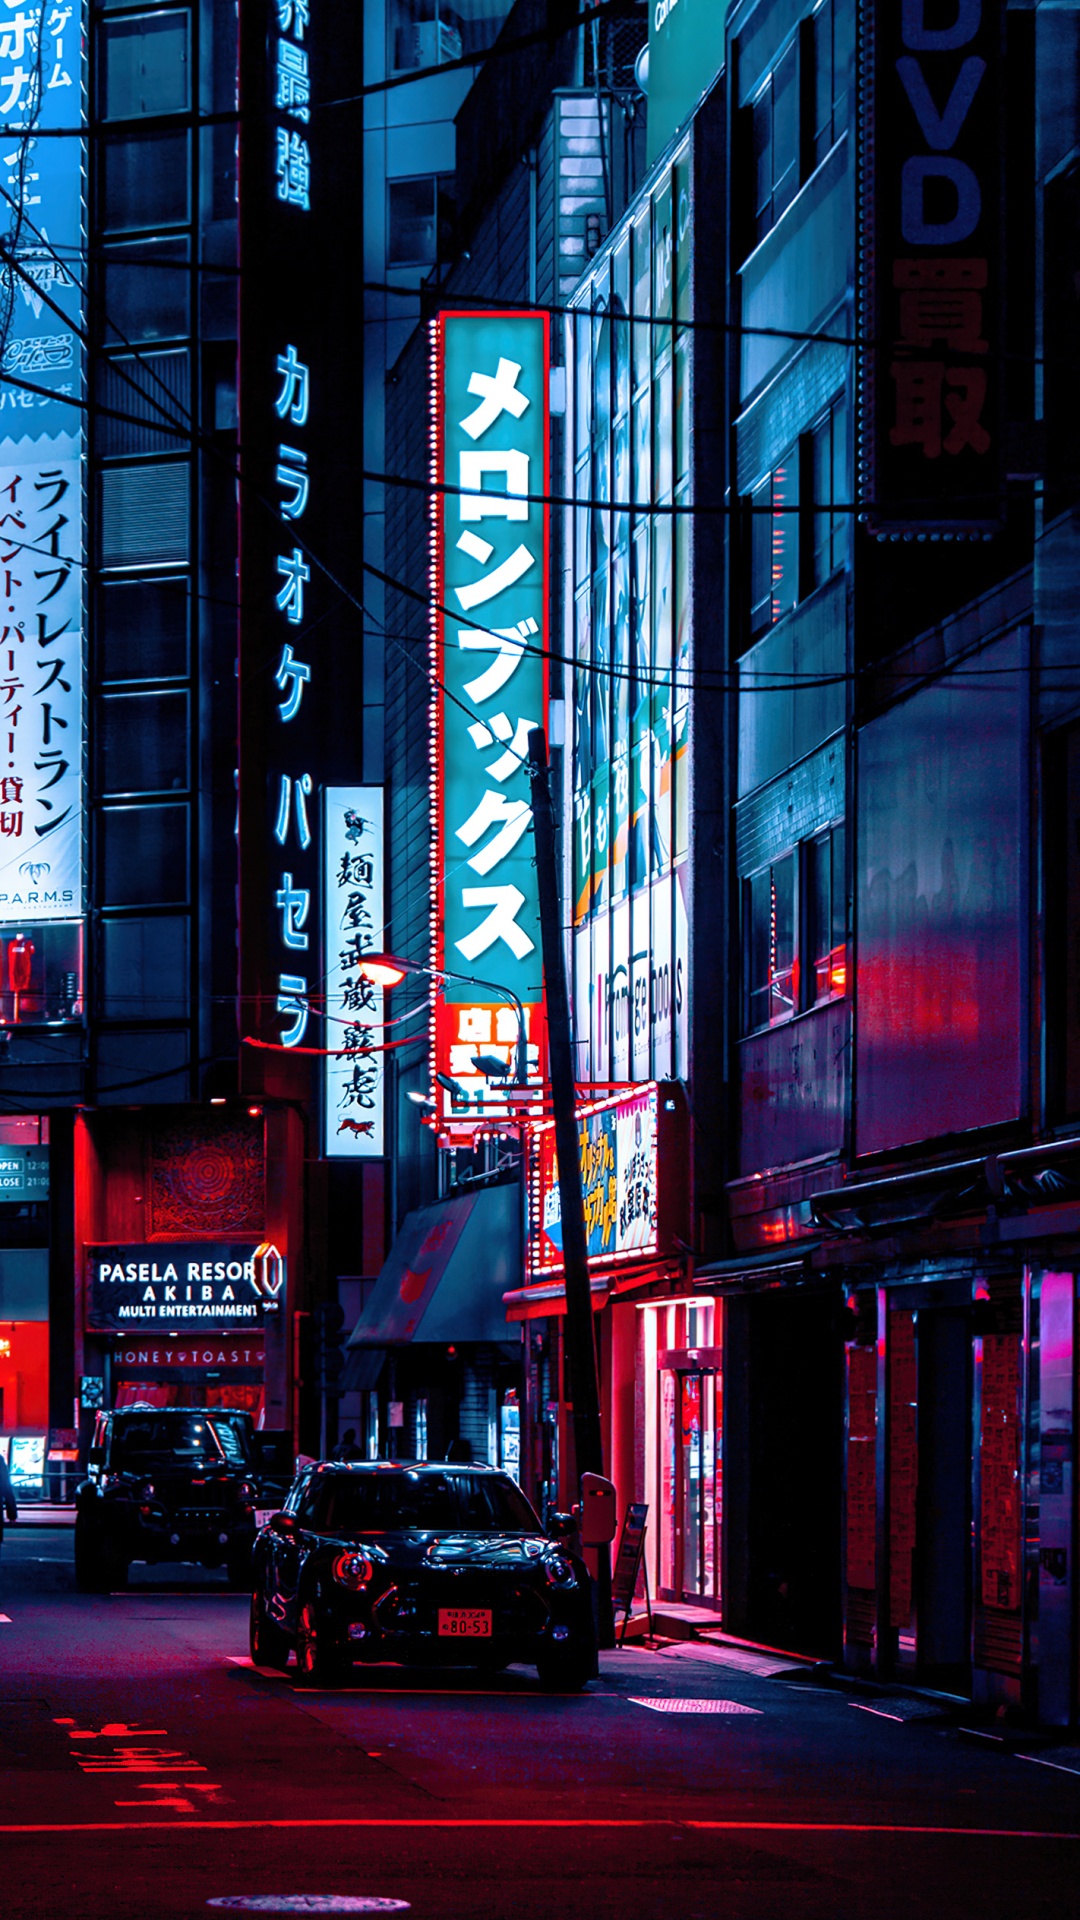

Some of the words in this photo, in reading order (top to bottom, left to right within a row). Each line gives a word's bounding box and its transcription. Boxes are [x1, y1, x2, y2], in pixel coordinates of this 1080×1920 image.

[32, 470, 73, 838] ライブレストラン
[454, 357, 539, 960] メロンブックス
[100, 1263, 178, 1282] PASELA
[118, 1305, 156, 1318] MULTI
[114, 1351, 173, 1363] HONEY
[192, 1351, 250, 1362] TOAST
[450, 1620, 489, 1634] 80-53
